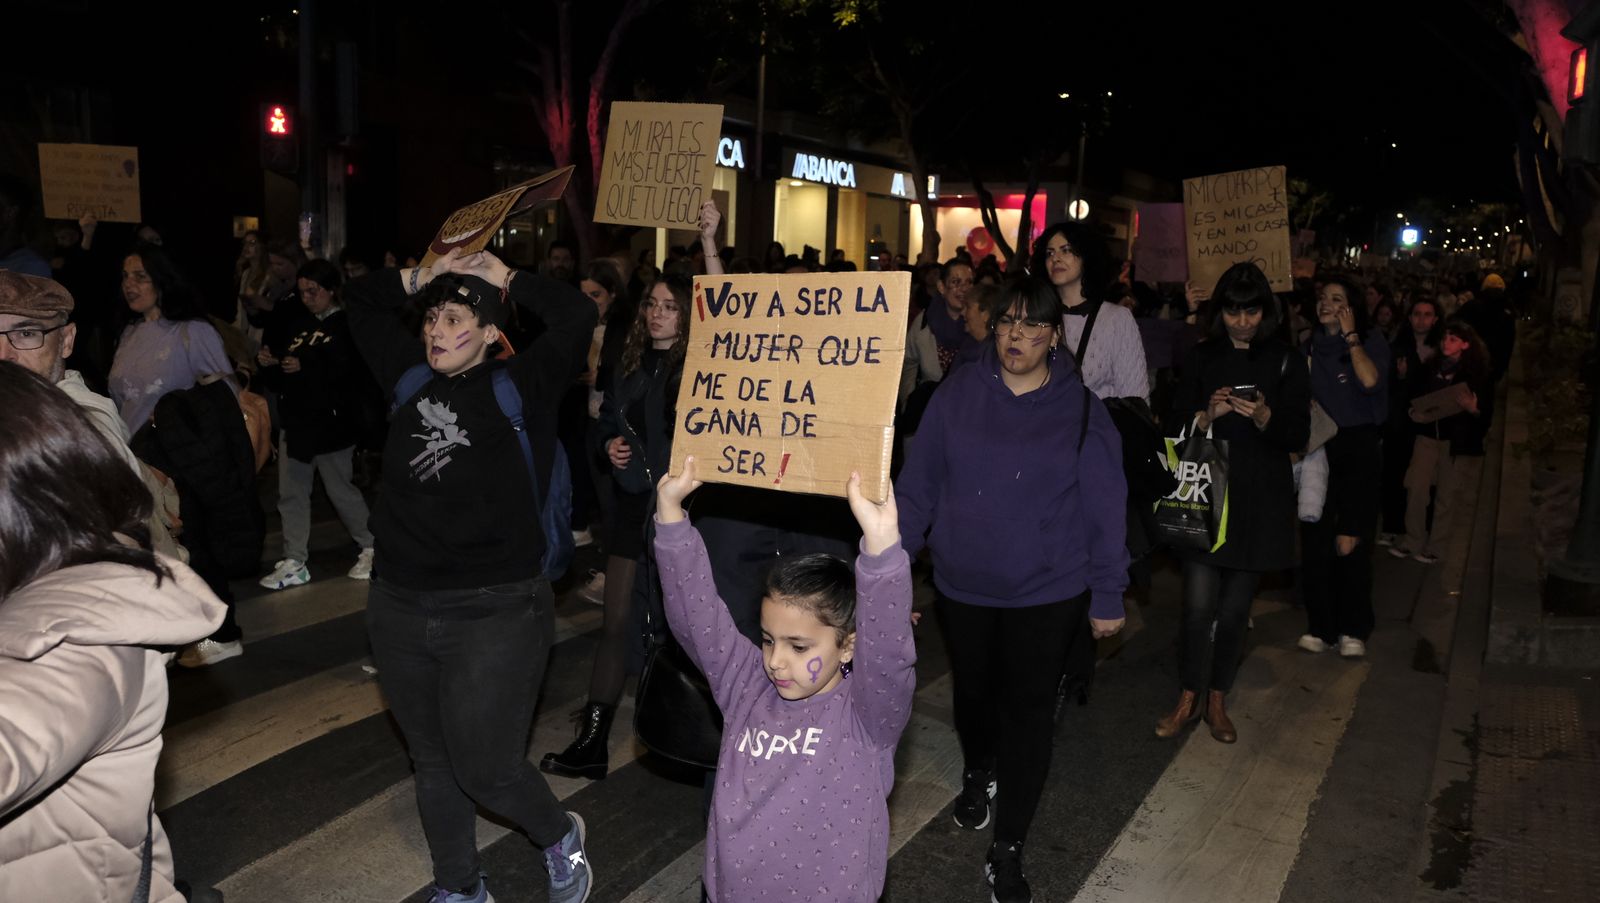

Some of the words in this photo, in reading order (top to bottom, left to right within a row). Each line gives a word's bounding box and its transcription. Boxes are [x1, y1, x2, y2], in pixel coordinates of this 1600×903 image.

[622, 119, 643, 151] MI
[646, 120, 674, 152] IRA
[678, 120, 705, 154] ES
[645, 151, 707, 186] FUERTE
[792, 152, 857, 189] ABANCA
[1187, 176, 1210, 206] MI
[1213, 166, 1284, 204] CUERPO
[606, 183, 643, 220] QUE
[643, 185, 669, 221] TU
[666, 186, 703, 225] EGO
[1194, 210, 1217, 226] ES
[1223, 207, 1242, 220] MI
[1244, 199, 1286, 218] CASA
[1192, 231, 1202, 241] Y
[1206, 228, 1226, 240] EN
[1234, 223, 1251, 234] MI
[1253, 218, 1290, 233] CASA
[1197, 239, 1258, 258] MANDO
[766, 290, 786, 318] A
[794, 286, 844, 317] SER
[854, 284, 890, 314] LA
[710, 331, 804, 364] MUJER
[817, 334, 883, 367] QUE
[691, 370, 728, 401] ME
[737, 376, 773, 403] DE
[783, 379, 817, 406] LA
[684, 407, 762, 438] GANA
[781, 411, 818, 438] DE
